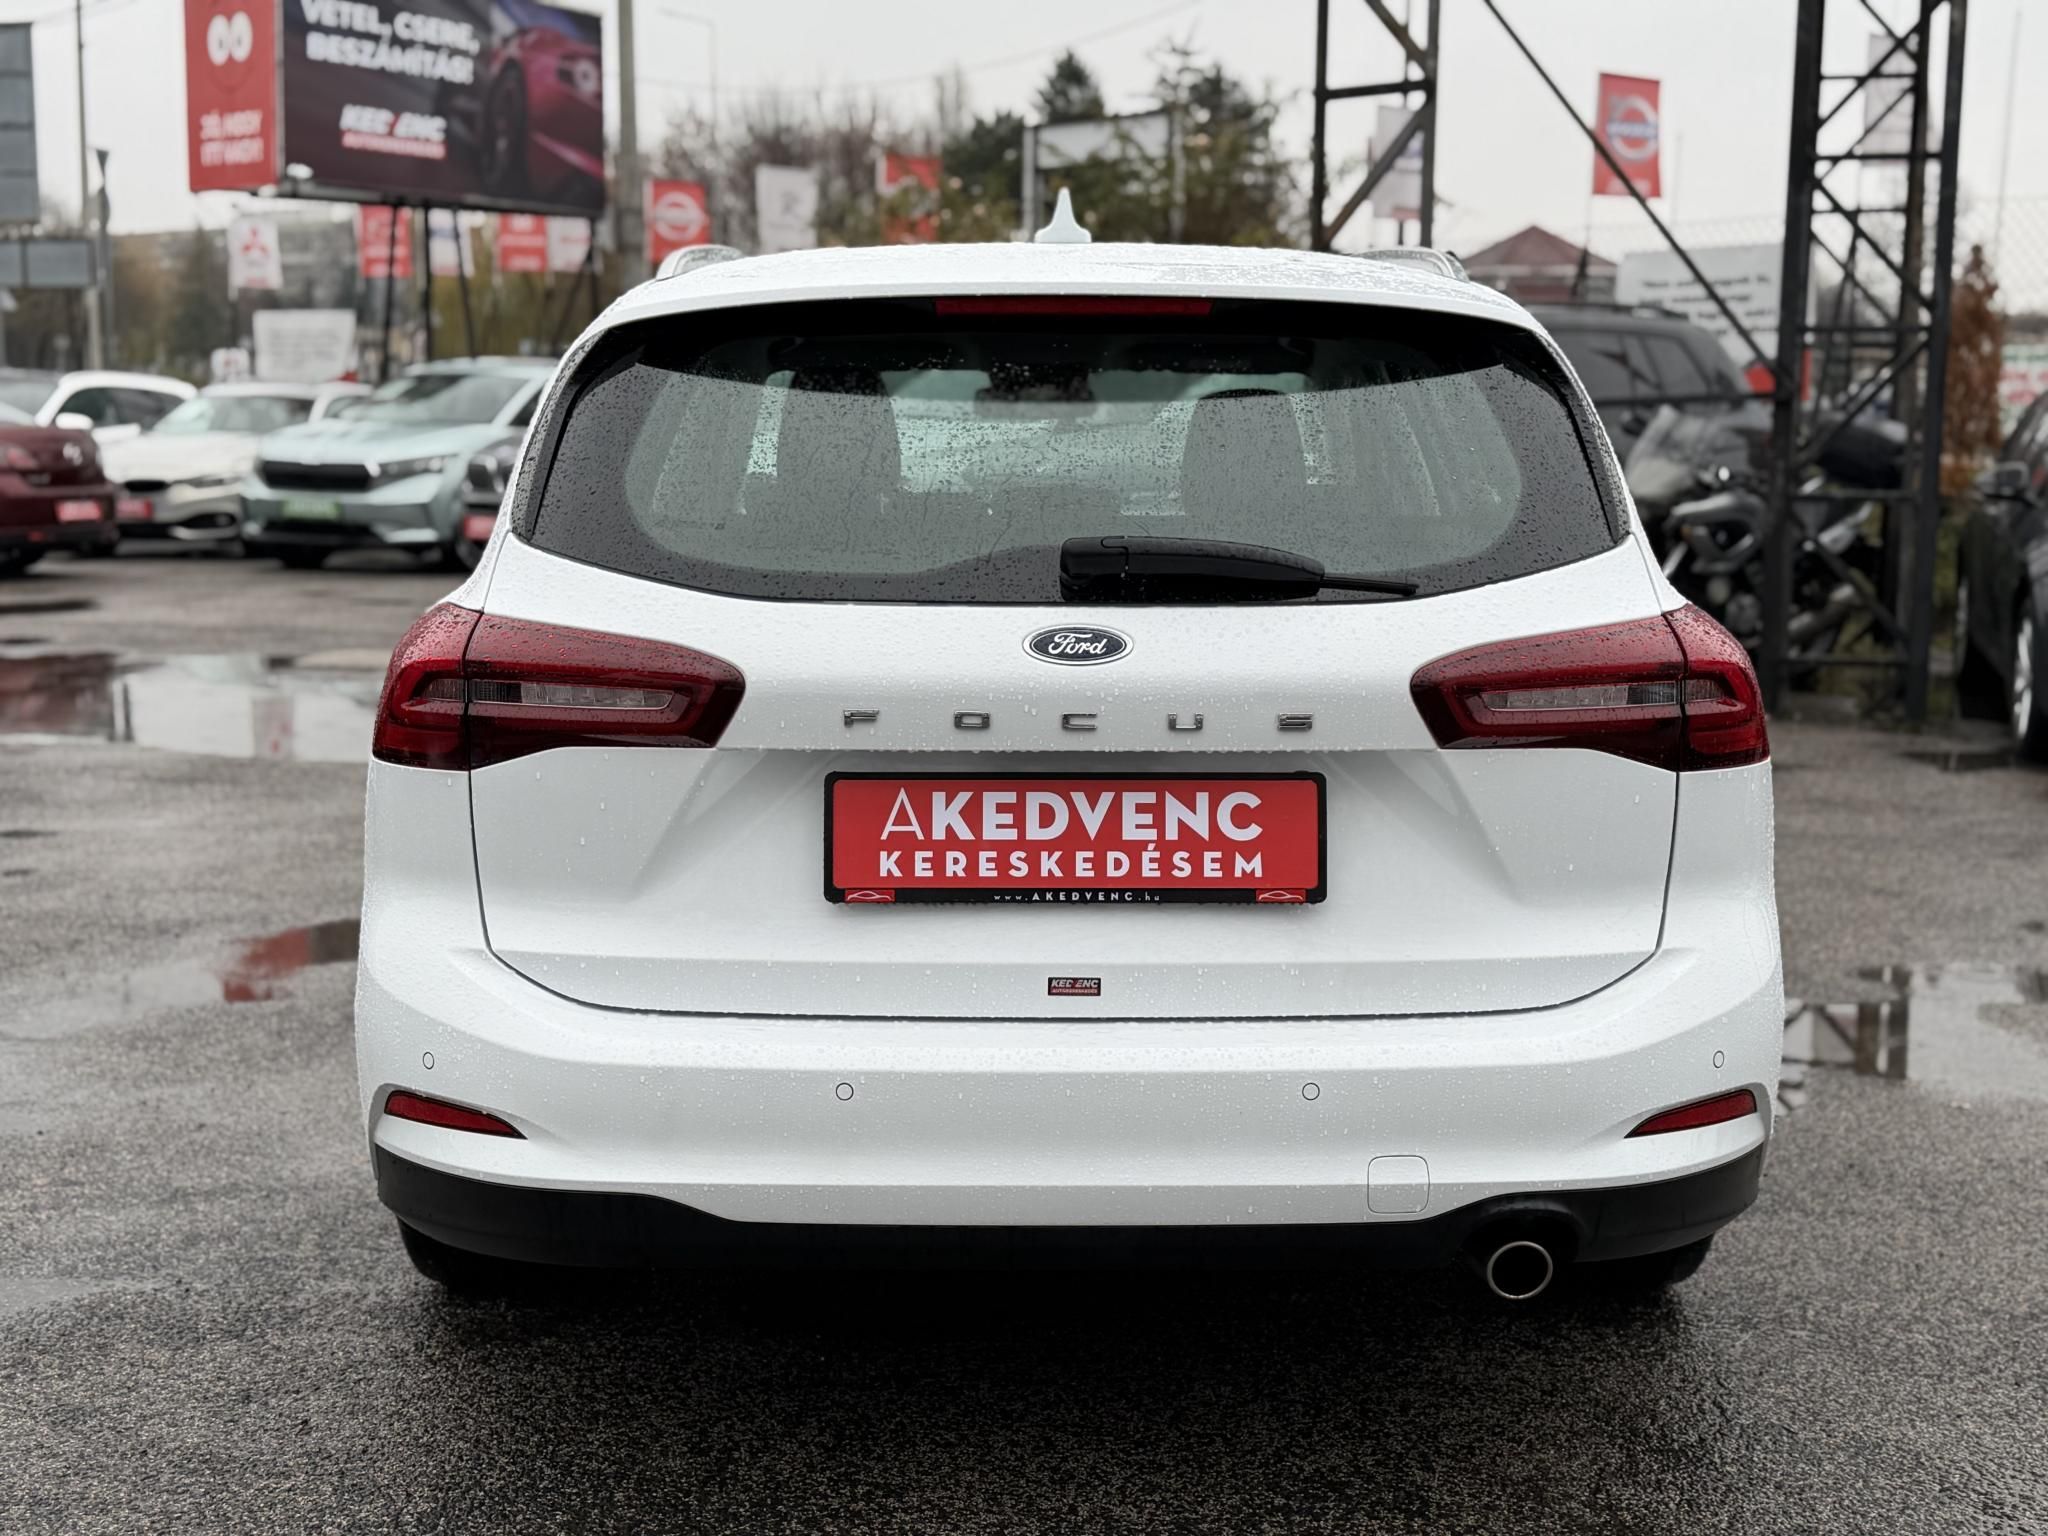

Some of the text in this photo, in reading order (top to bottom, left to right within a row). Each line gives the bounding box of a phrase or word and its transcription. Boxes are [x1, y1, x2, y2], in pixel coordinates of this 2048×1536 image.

[1048, 632, 1108, 655] Ford
[843, 708, 1314, 731] FOCUS
[879, 843, 1263, 878] KERESKEDÉSEM
[993, 891, 1160, 901] www.AKEDVENC.hu
